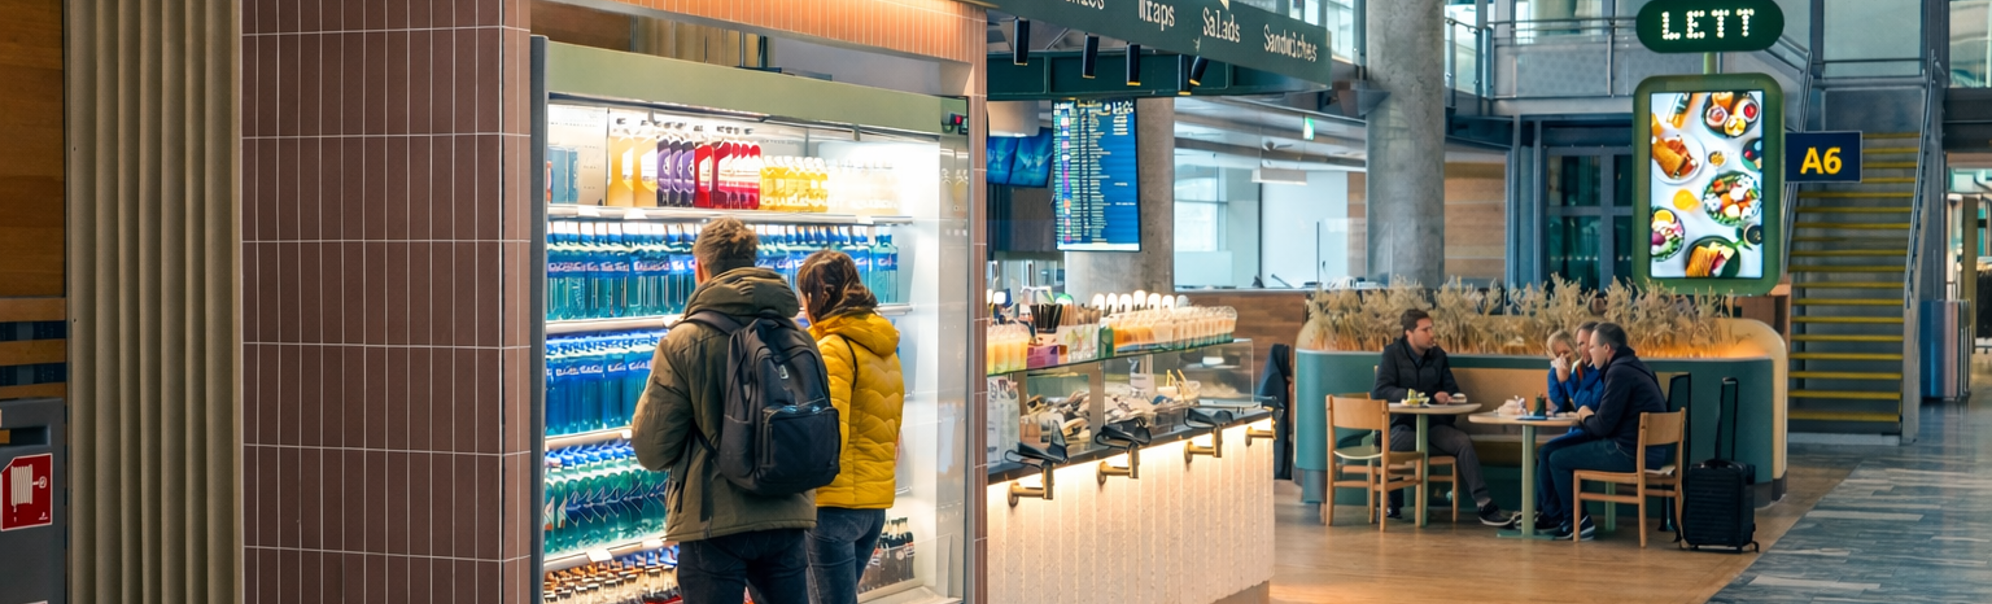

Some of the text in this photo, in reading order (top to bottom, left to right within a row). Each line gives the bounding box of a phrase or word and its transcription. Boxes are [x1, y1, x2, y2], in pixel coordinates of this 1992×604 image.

[1138, 0, 1175, 31] Wraps
[1202, 6, 1241, 43] Salads
[1661, 8, 1755, 40] LETT
[1263, 23, 1318, 63] Sandwiches
[1799, 146, 1843, 175] A6
